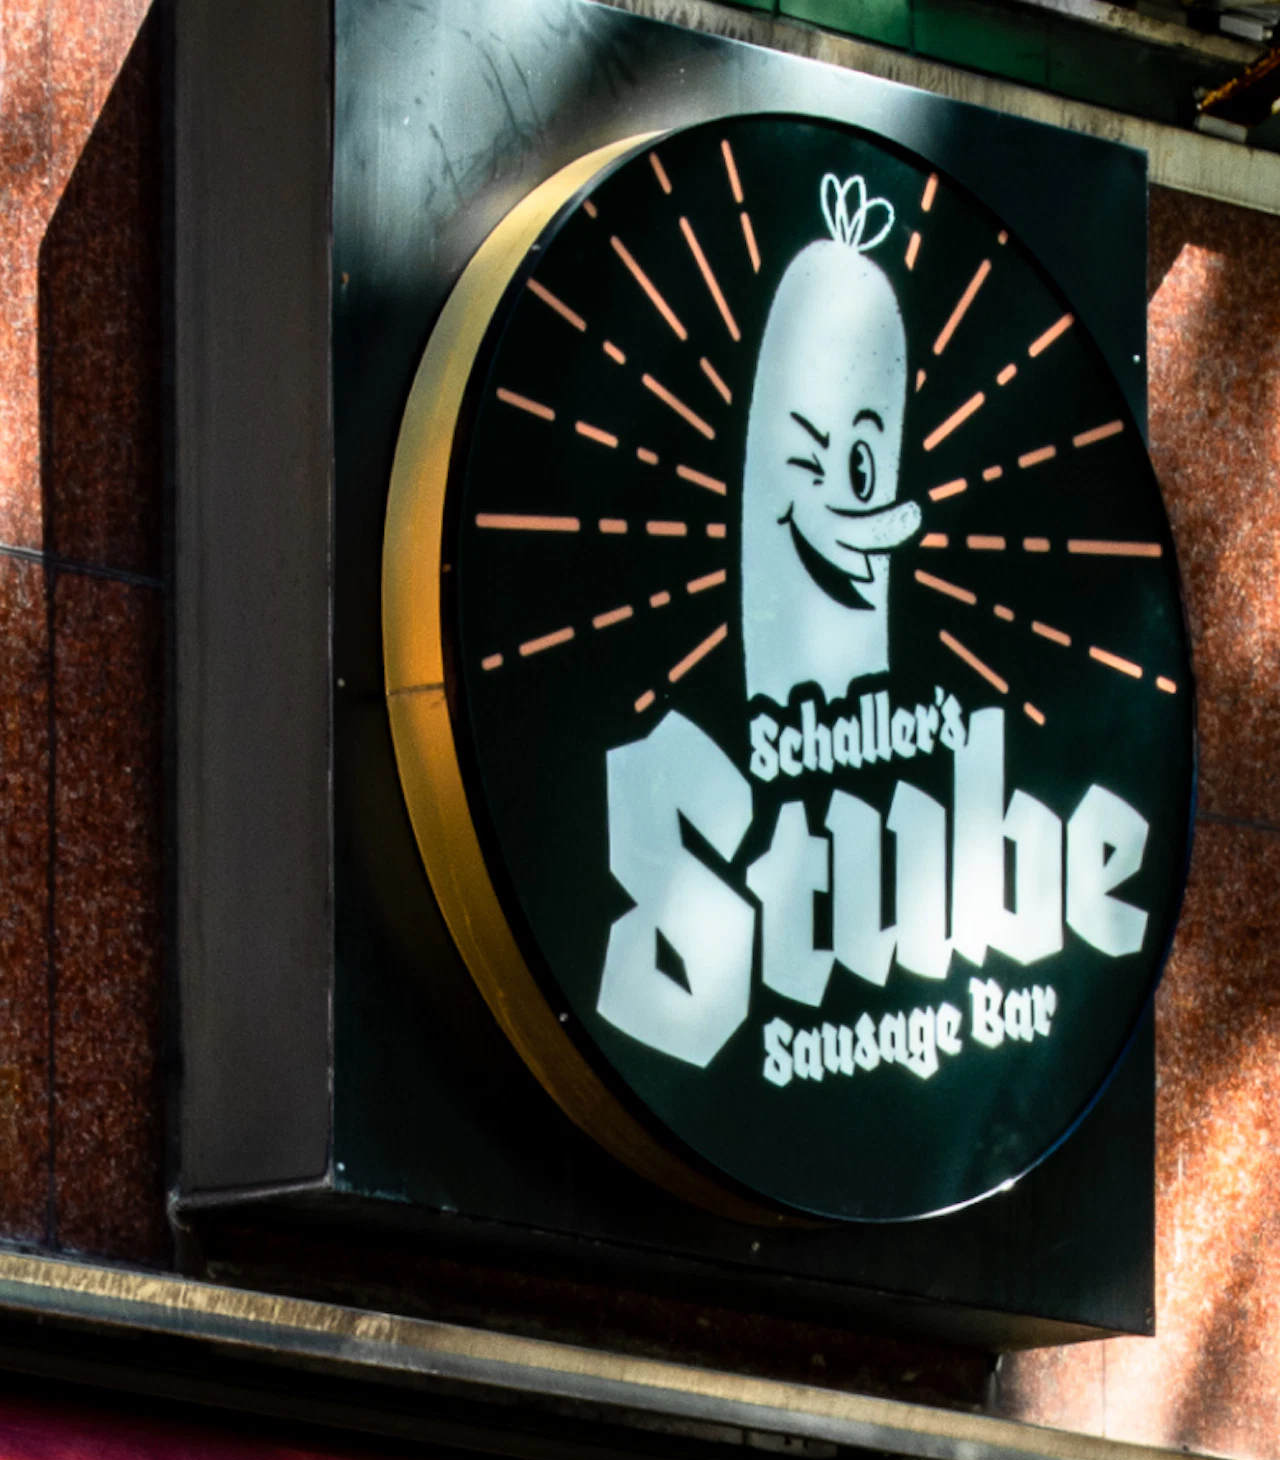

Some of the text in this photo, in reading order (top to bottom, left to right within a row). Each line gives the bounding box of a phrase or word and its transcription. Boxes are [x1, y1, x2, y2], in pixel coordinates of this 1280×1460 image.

[749, 686, 969, 782] Schaller's
[597, 706, 1150, 1069] Stube
[763, 977, 1058, 1088] Sausage Bar
